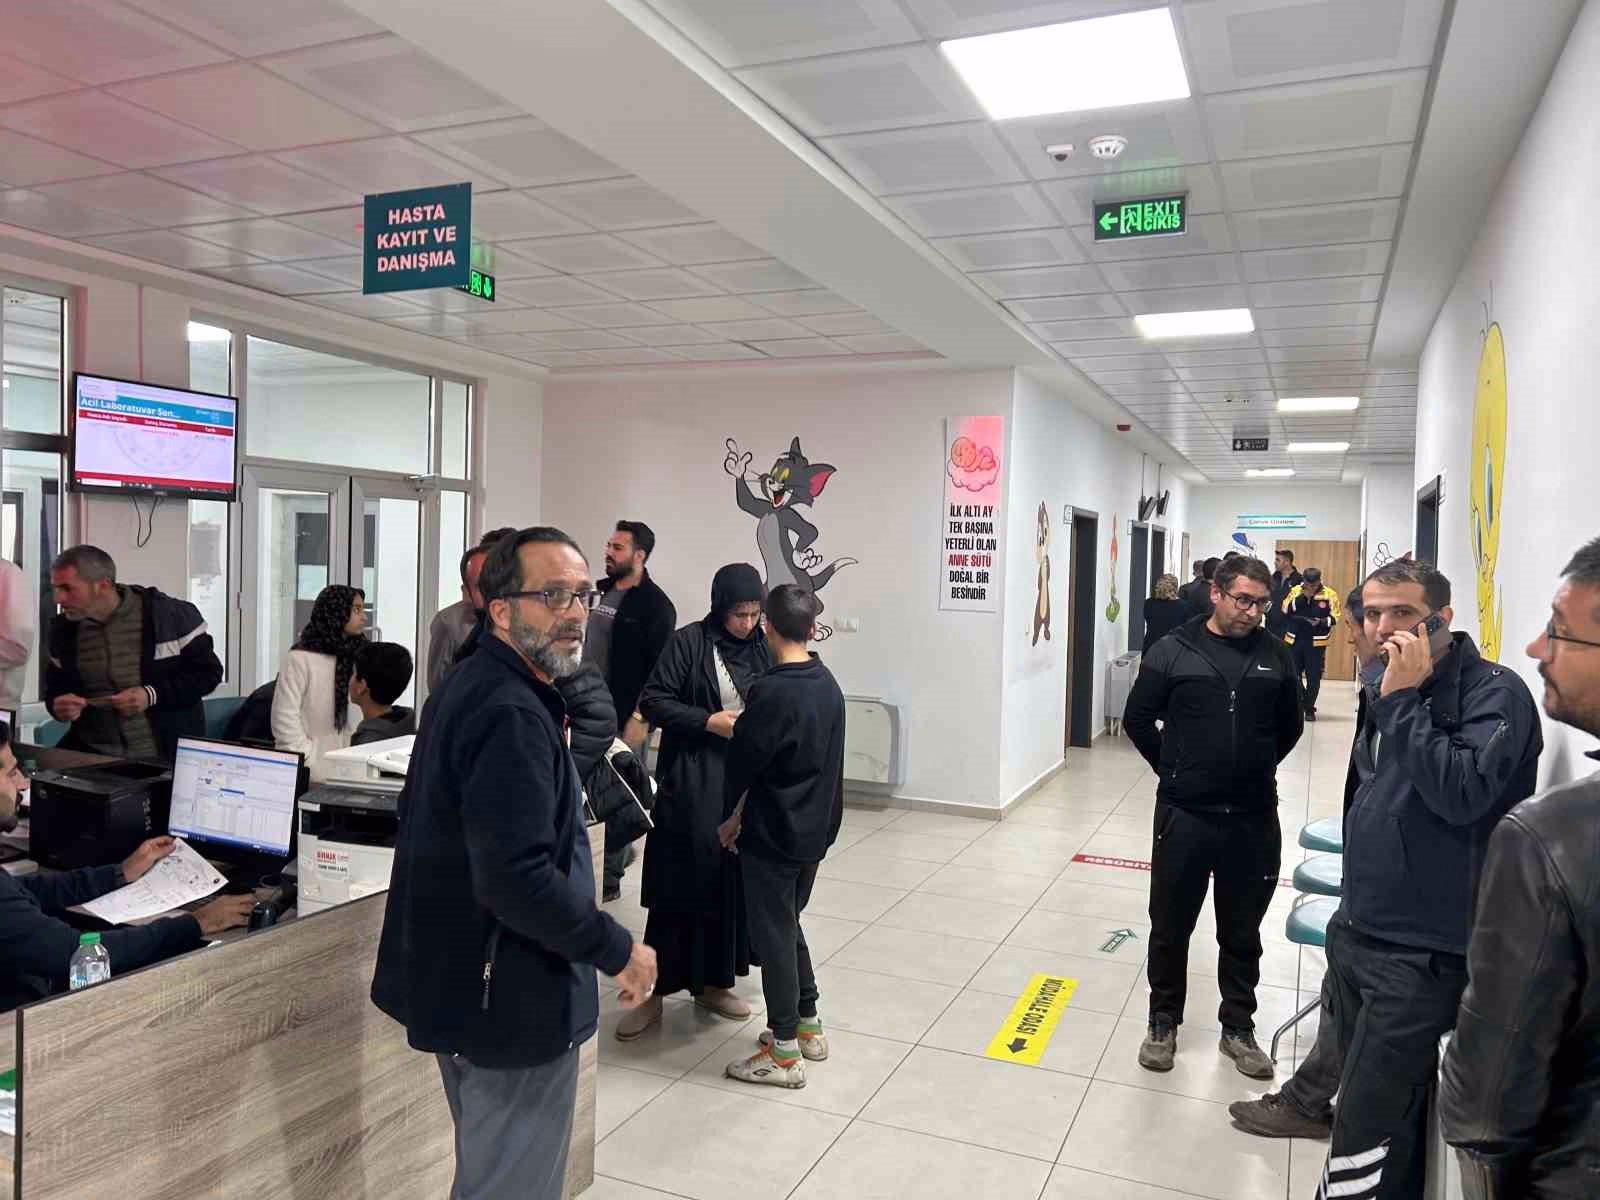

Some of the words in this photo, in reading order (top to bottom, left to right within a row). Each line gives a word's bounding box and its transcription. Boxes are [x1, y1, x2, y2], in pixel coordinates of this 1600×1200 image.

[388, 203, 446, 225] HASTA
[1144, 200, 1181, 218] EXIT
[377, 229, 429, 249] KAYIT
[433, 226, 457, 243] VE
[377, 249, 456, 273] DANIŞMA
[80, 398, 98, 408] Acil
[100, 400, 156, 416] Laboratuvar
[949, 502, 962, 517] İLK
[964, 504, 980, 518] ALTI
[982, 505, 993, 518] AY
[949, 521, 963, 534] TEK
[964, 521, 993, 537] BAŞINA
[945, 536, 974, 550] YETERLİ
[976, 538, 997, 551] OLAN
[948, 554, 969, 567] ANNE
[970, 553, 992, 568] SÜTÜ
[949, 567, 974, 583] DOĞAL
[976, 569, 989, 584] BİR
[951, 585, 986, 600] BESİNDİR
[1015, 1012, 1044, 1036] ODASI
